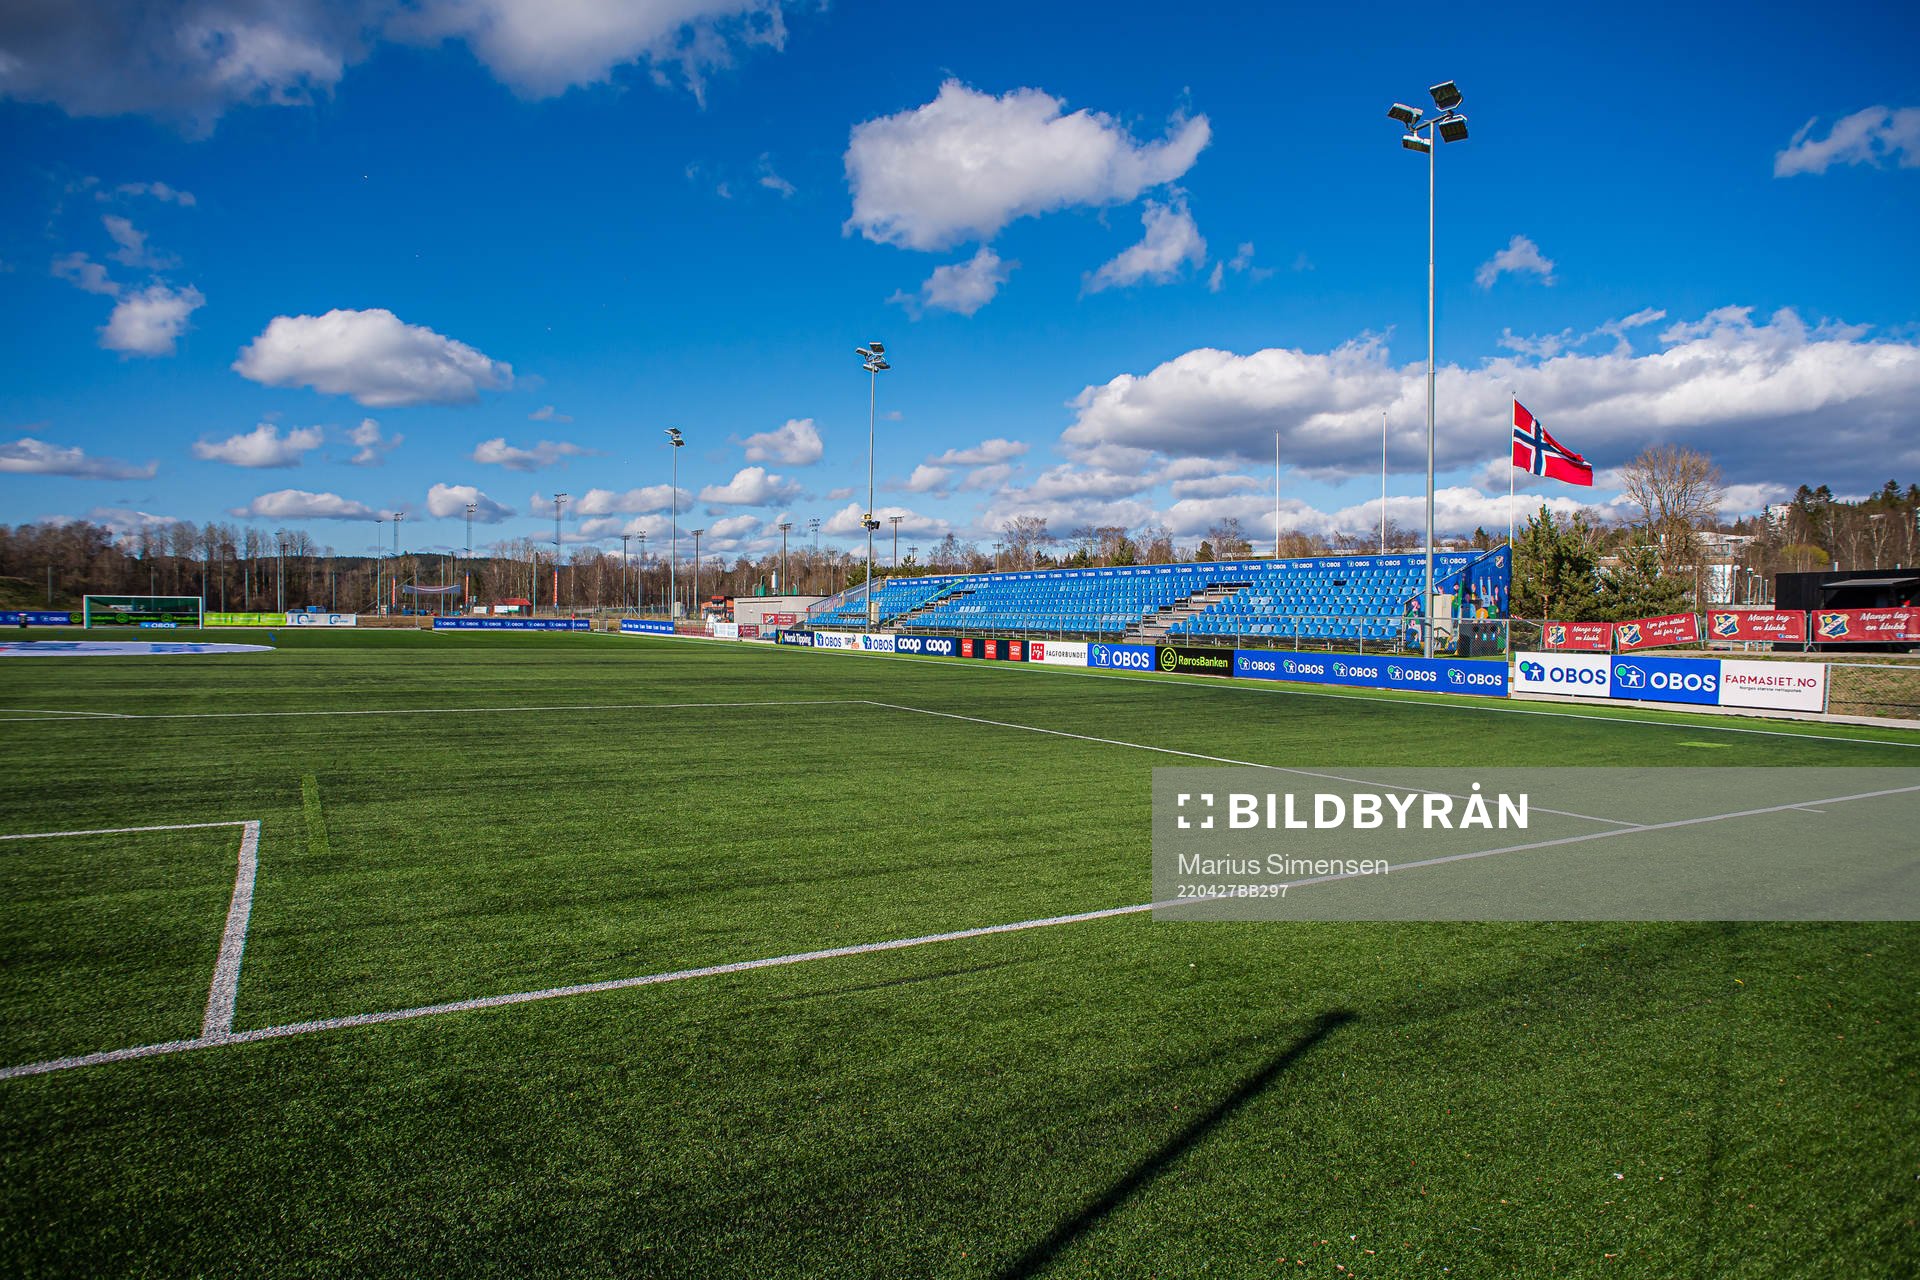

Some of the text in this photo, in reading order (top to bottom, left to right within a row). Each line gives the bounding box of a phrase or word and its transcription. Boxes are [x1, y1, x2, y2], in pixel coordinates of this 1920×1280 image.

[784, 632, 811, 646] Norsk Tipping
[825, 636, 842, 647] OBOS
[873, 639, 893, 651] OBOS
[1046, 650, 1087, 659] FAGFORBUNDET
[1112, 650, 1150, 669] OBOS
[1178, 655, 1229, 669] RørosBanken
[1251, 660, 1276, 671] OBOS
[1297, 663, 1324, 675] OBOS
[1349, 667, 1378, 678] OBOS
[1405, 670, 1437, 682] OBOS
[1467, 673, 1502, 686] OBOS
[1550, 666, 1607, 686] OBOS
[1650, 671, 1717, 693] OBOS
[1725, 674, 1817, 688] FARMASIET.NO
